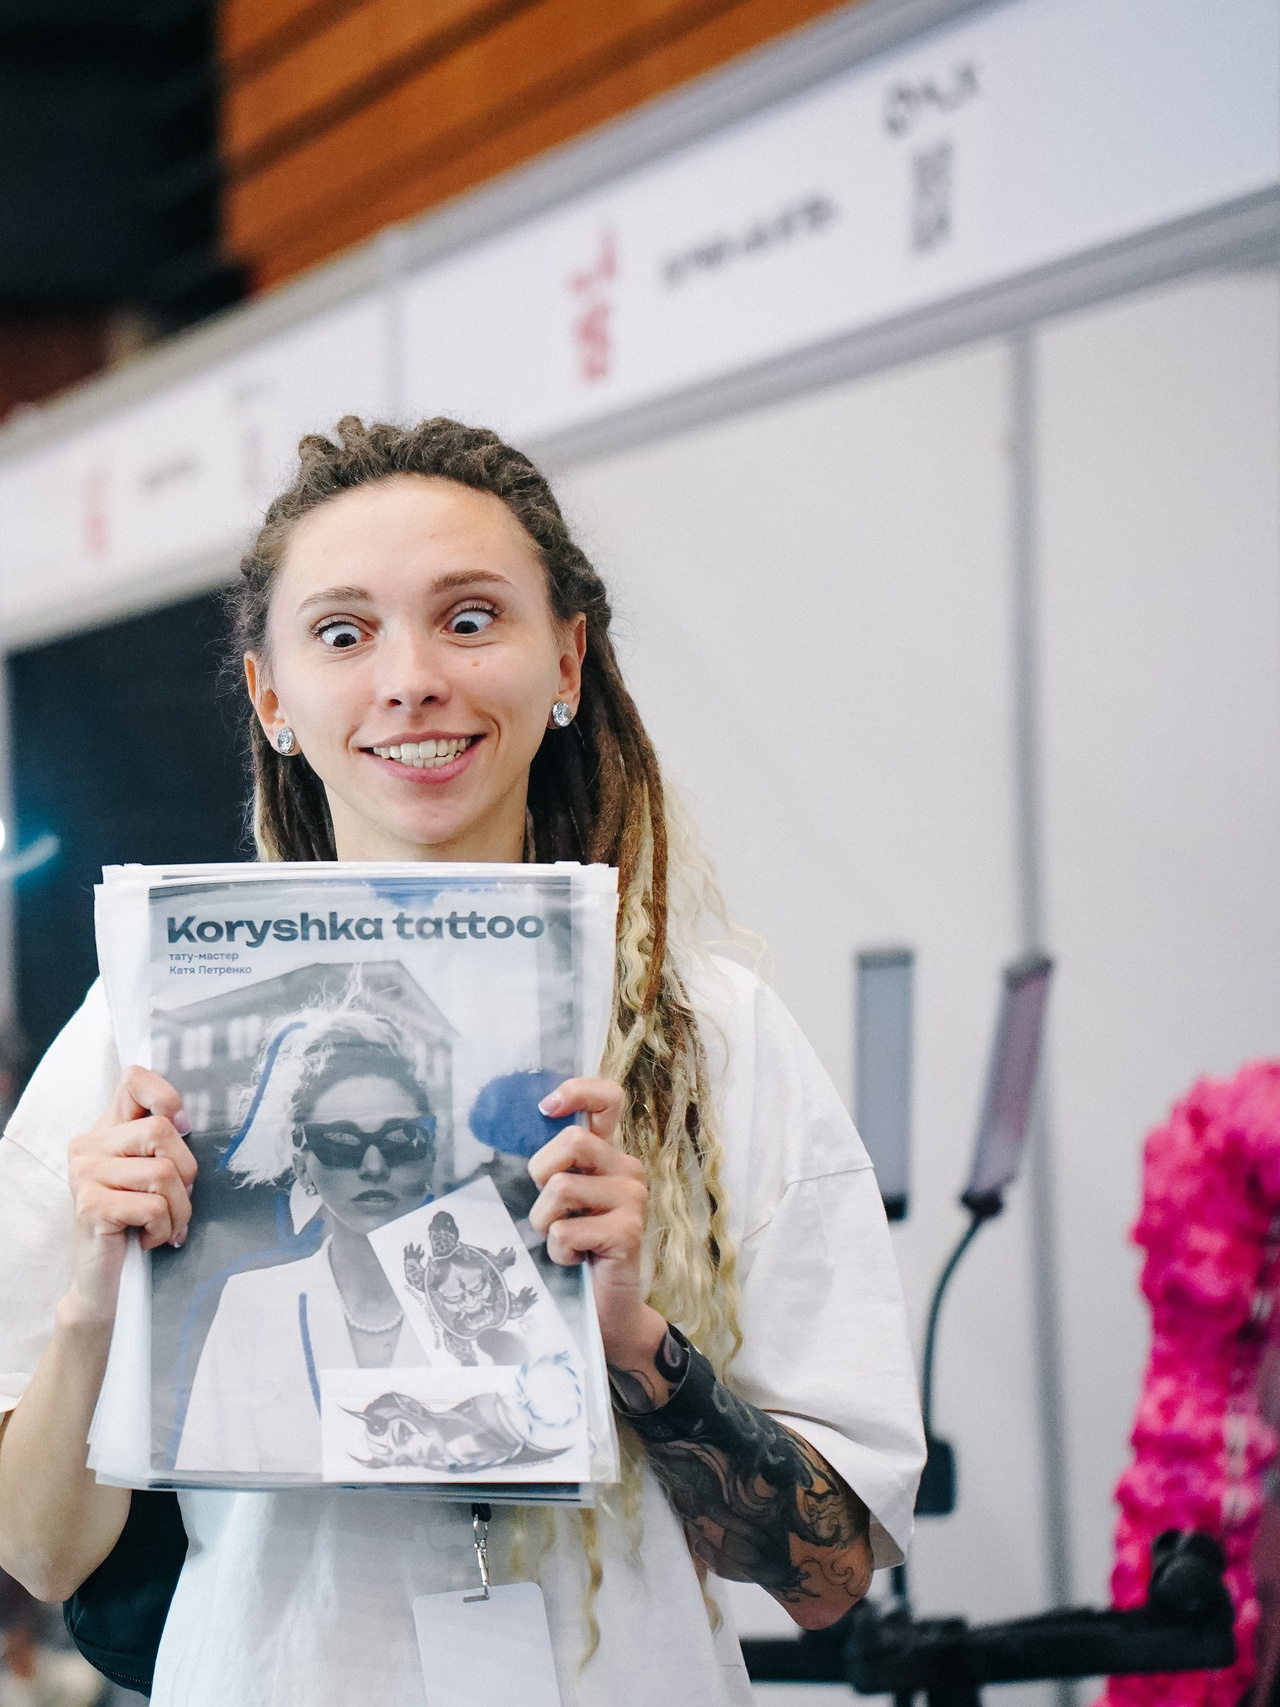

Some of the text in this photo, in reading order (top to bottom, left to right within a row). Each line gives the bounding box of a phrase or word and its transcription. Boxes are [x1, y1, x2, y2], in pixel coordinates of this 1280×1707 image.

[167, 911, 545, 948] Koryshka tattoo
[168, 952, 239, 963] тату-мастер
[169, 965, 252, 976] Катя Петренко
